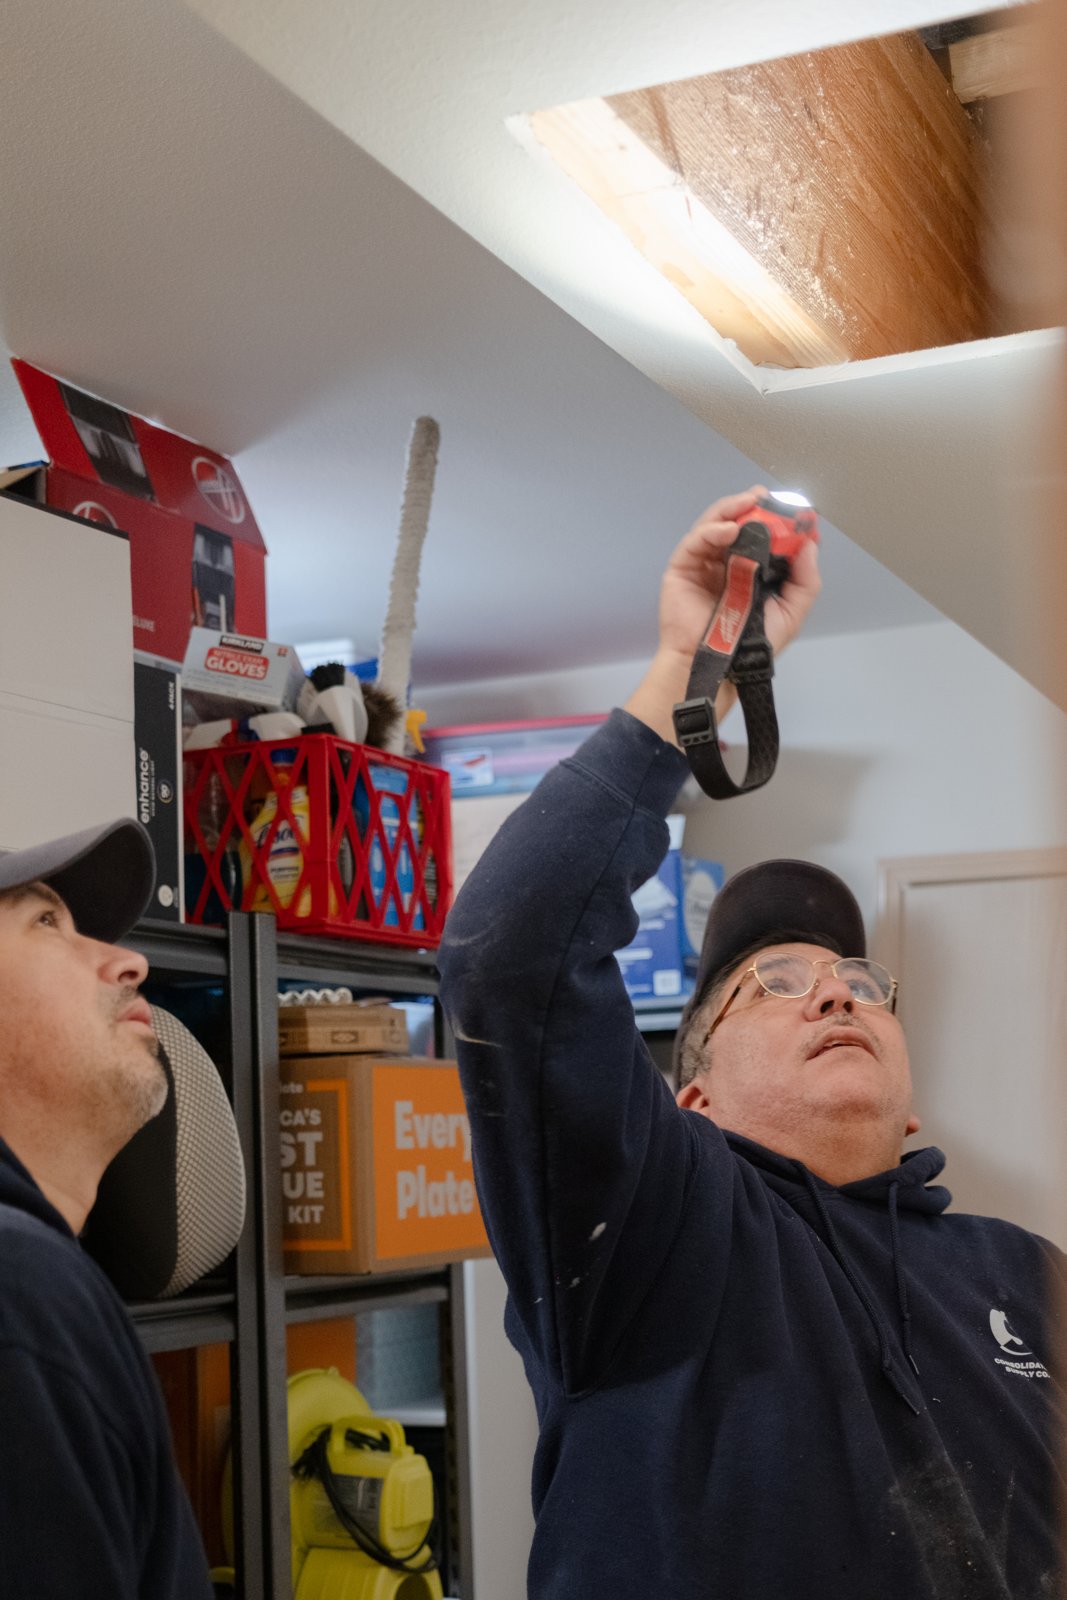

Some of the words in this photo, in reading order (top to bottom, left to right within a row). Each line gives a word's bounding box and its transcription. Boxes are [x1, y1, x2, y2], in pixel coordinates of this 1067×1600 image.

[221, 636, 263, 650] KIRKLAND
[206, 656, 266, 678] GLOVES
[139, 749, 150, 824] enhance
[283, 1171, 324, 1200] UE
[396, 1164, 475, 1220] Plate
[288, 1205, 325, 1225] KIT
[1036, 1370, 1050, 1378] CO.
